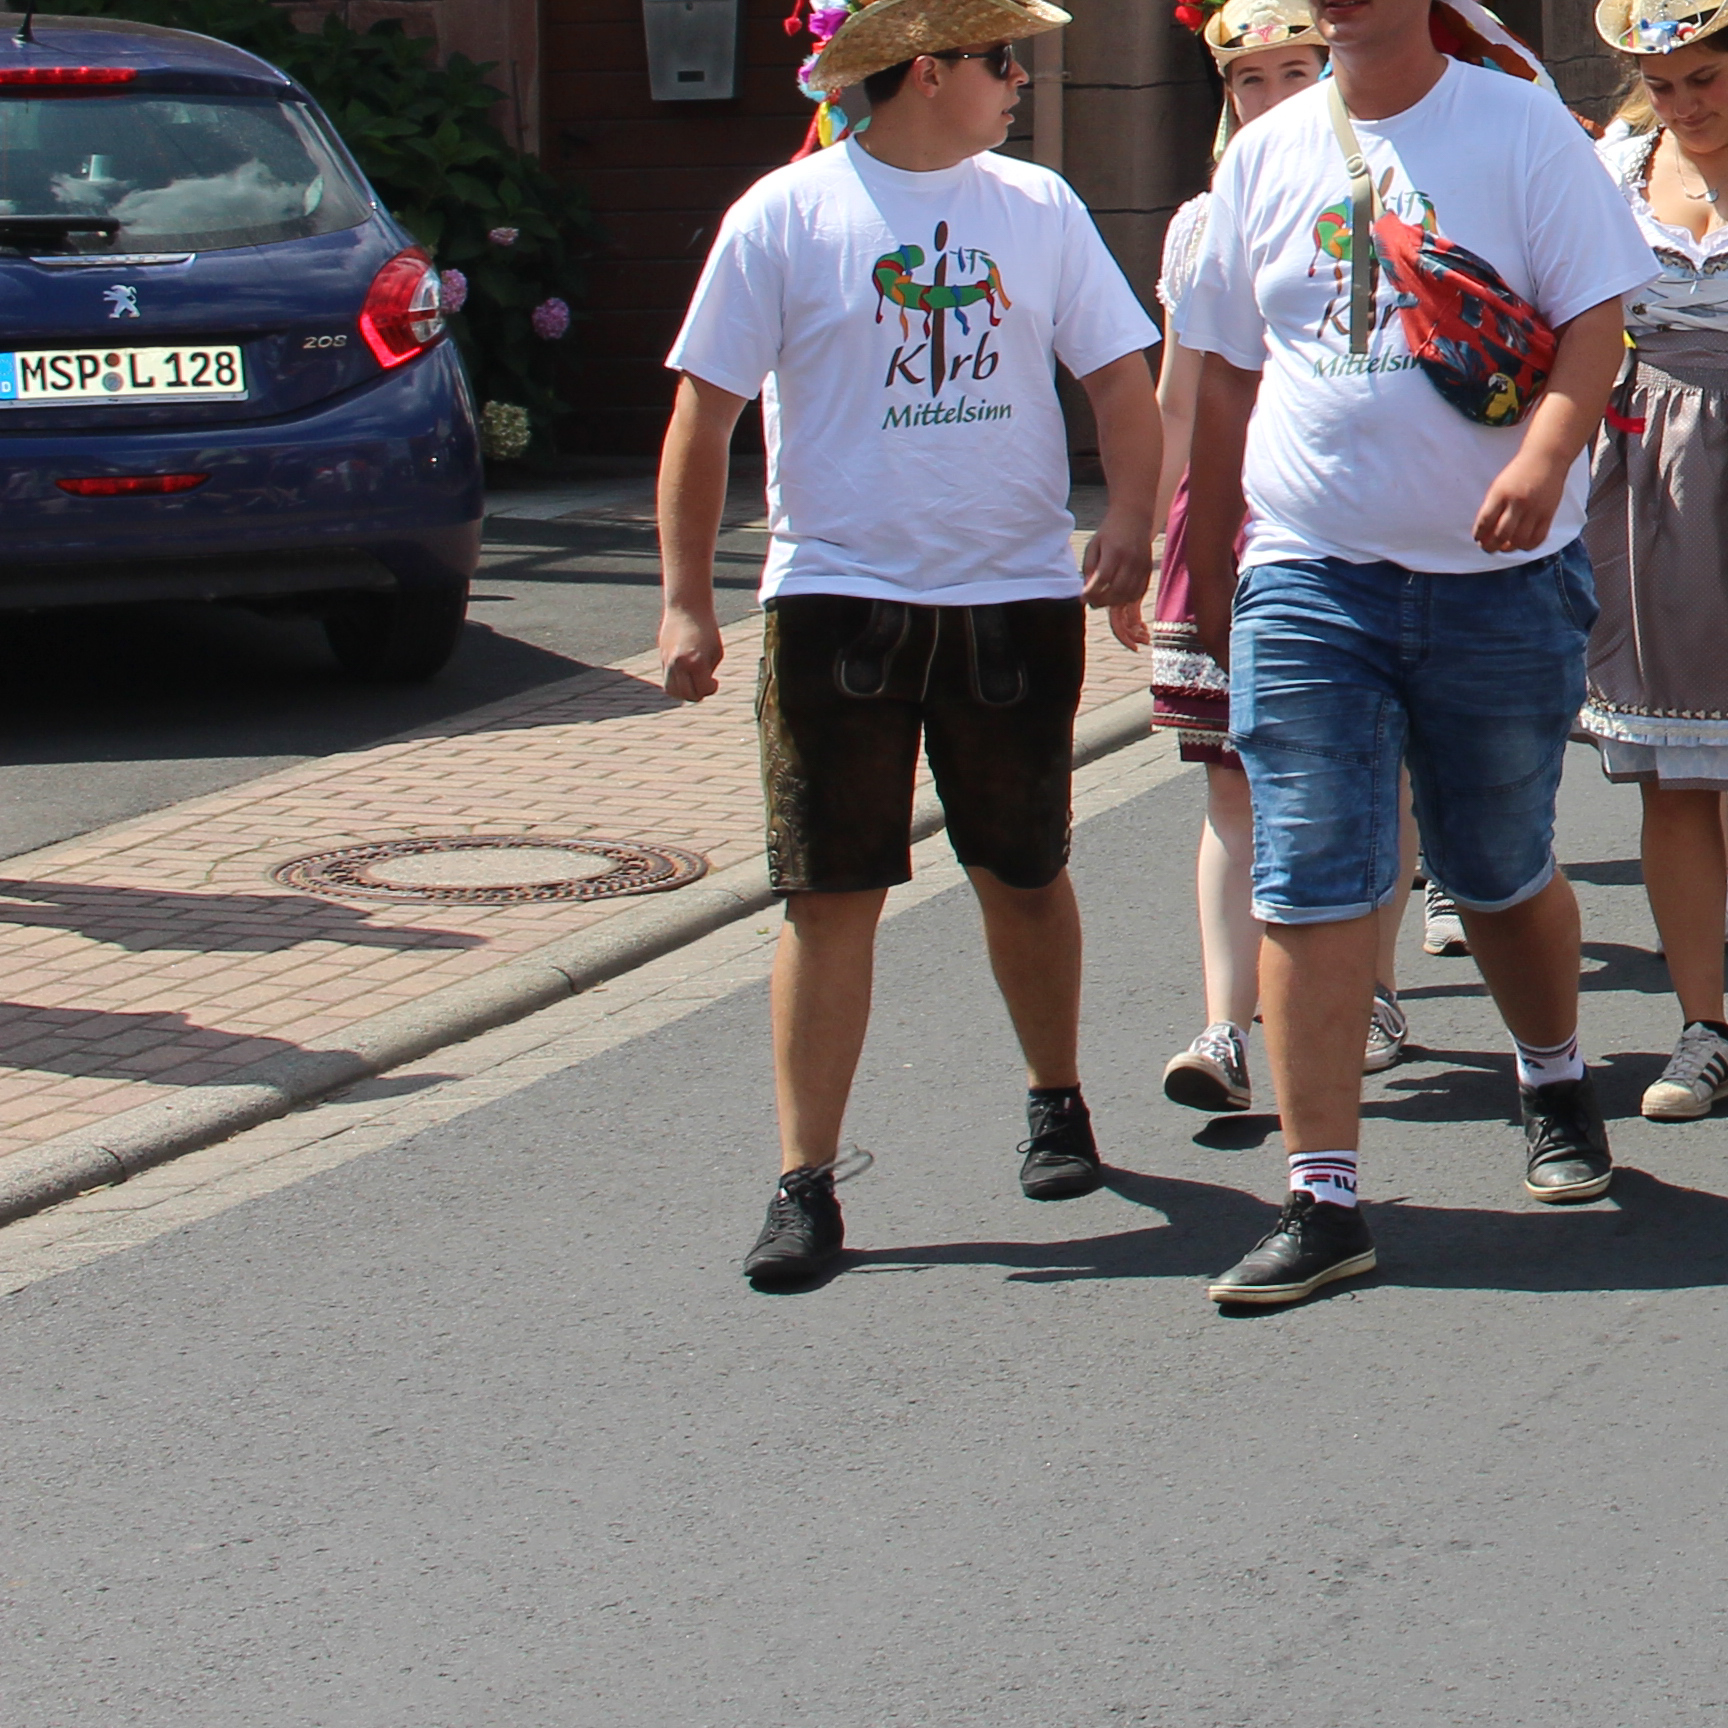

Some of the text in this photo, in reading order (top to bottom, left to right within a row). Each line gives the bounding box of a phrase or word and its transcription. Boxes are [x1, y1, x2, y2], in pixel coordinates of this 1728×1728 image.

[303, 334, 348, 350] 208
[20, 351, 238, 392] MSP L 128
[881, 395, 1013, 430] Mittelsinn
[1304, 1174, 1357, 1194] FIL
